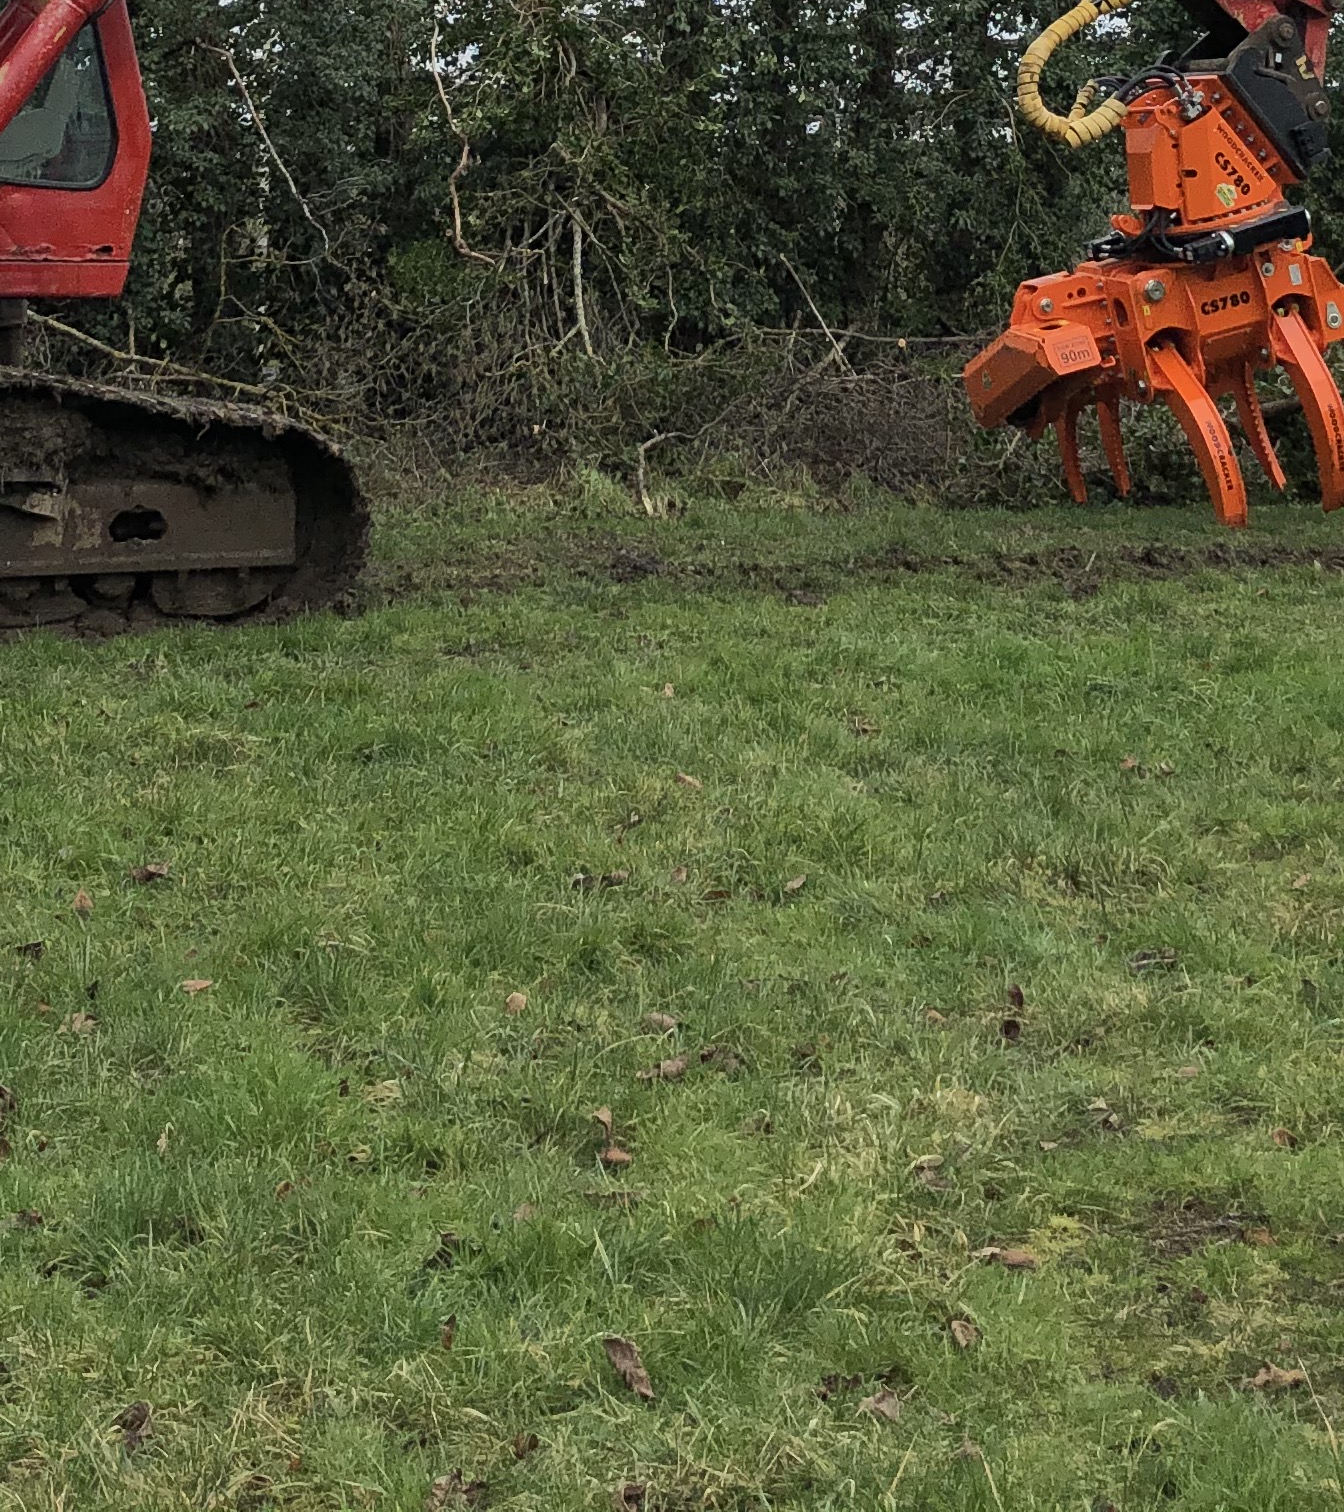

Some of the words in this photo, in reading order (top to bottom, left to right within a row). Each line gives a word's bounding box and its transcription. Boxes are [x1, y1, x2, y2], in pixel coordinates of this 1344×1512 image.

[1215, 152, 1251, 196] CS780
[1200, 290, 1251, 316] CS780
[1060, 349, 1091, 364] 90m
